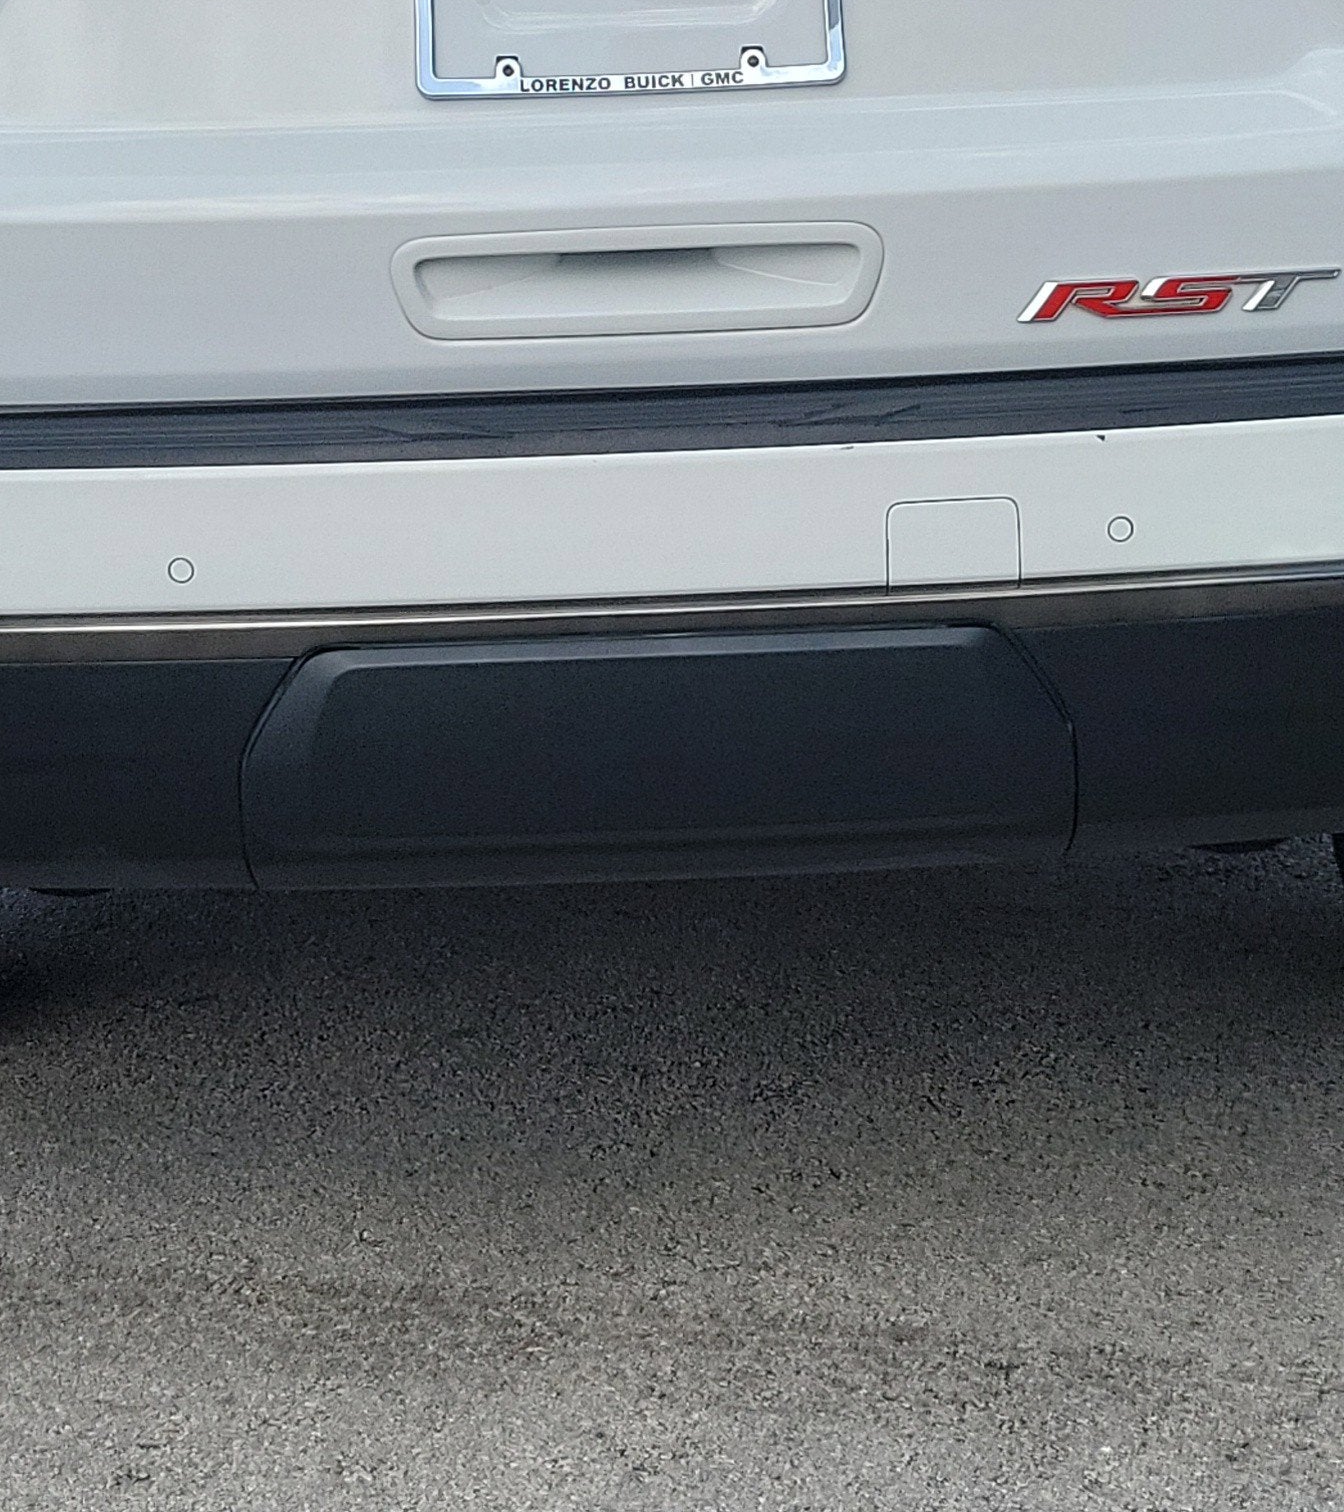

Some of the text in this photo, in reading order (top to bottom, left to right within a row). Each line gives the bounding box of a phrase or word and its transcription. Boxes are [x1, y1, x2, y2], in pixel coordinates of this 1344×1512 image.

[520, 70, 745, 93] LORENZO BUICK GMC
[1016, 268, 1343, 324] RST
